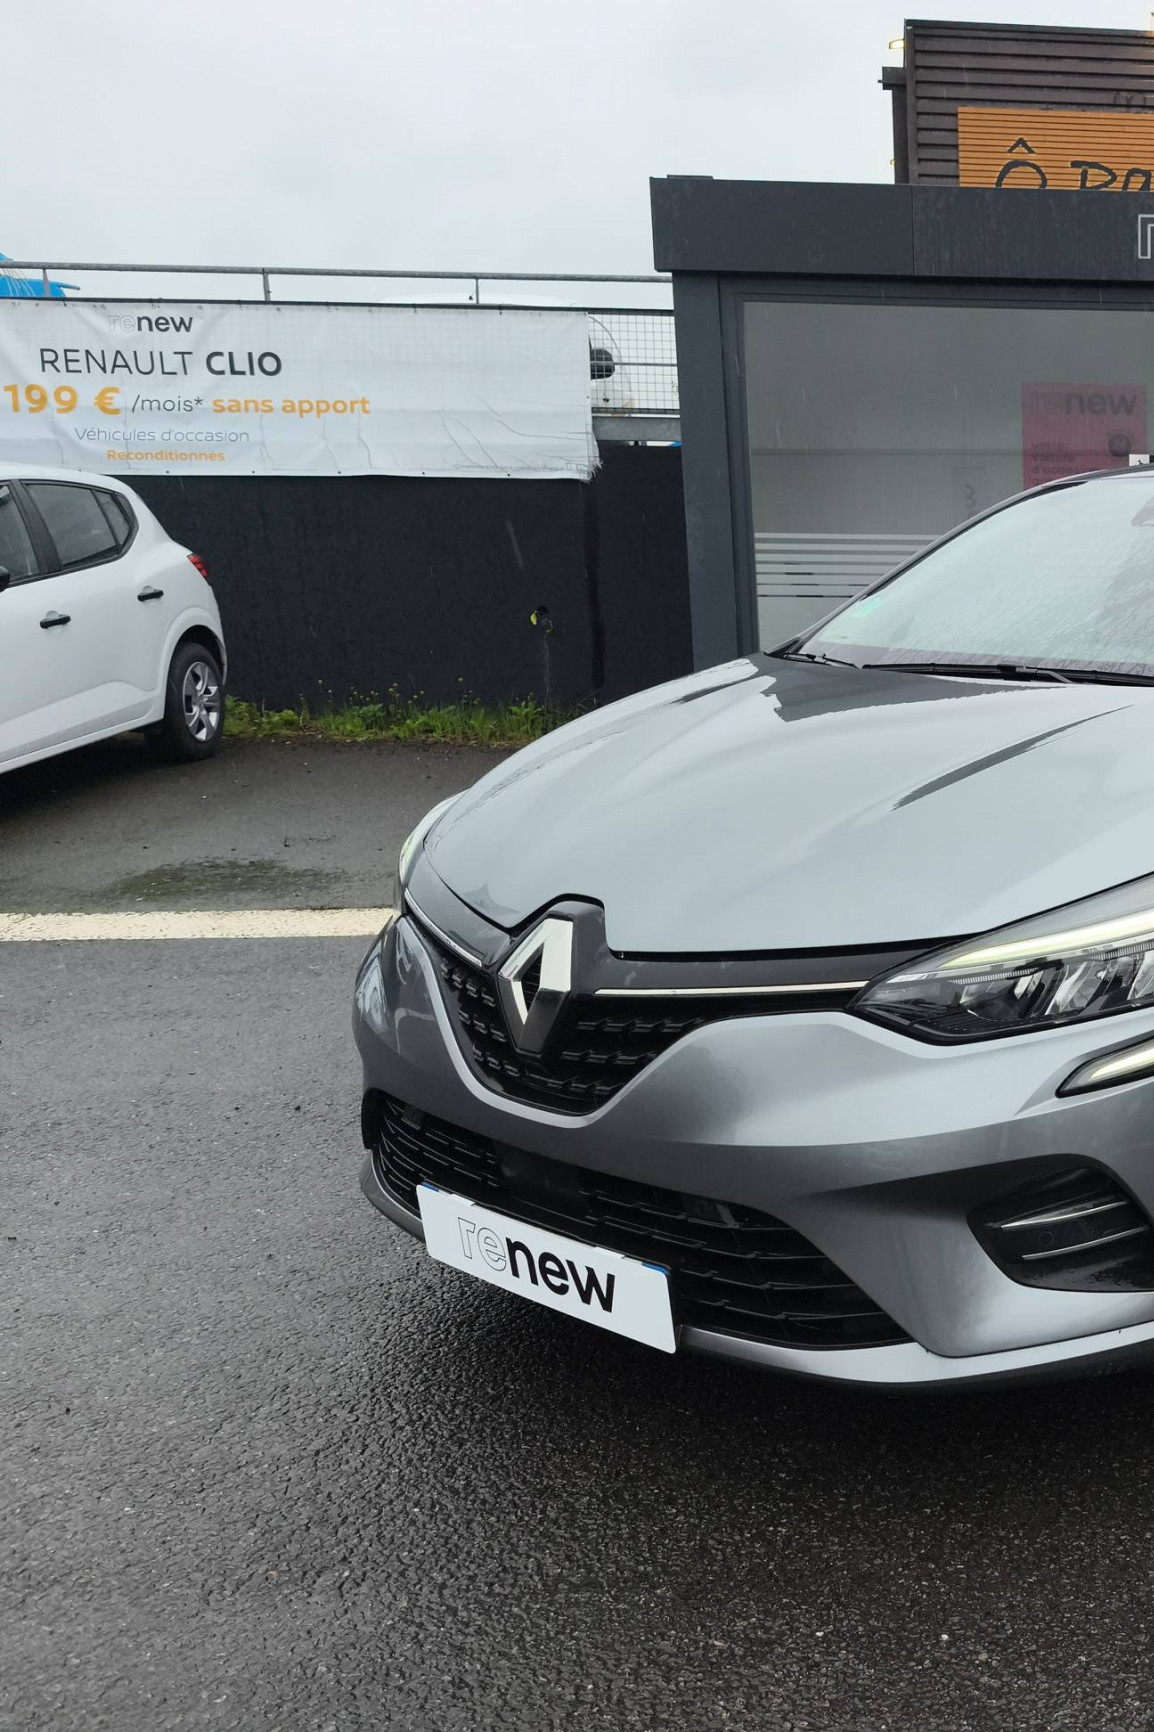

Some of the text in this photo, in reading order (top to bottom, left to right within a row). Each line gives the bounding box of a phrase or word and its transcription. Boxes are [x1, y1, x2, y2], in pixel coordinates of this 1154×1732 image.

[108, 315, 193, 333] renew
[39, 348, 282, 376] RENAULT CLIO
[3, 384, 78, 415] 199
[94, 386, 122, 416] €
[212, 398, 274, 414] sans
[281, 397, 371, 418] apport
[1032, 391, 1138, 415] renew
[75, 427, 250, 443] Véhicules d'occasion
[457, 1216, 616, 1313] renew
